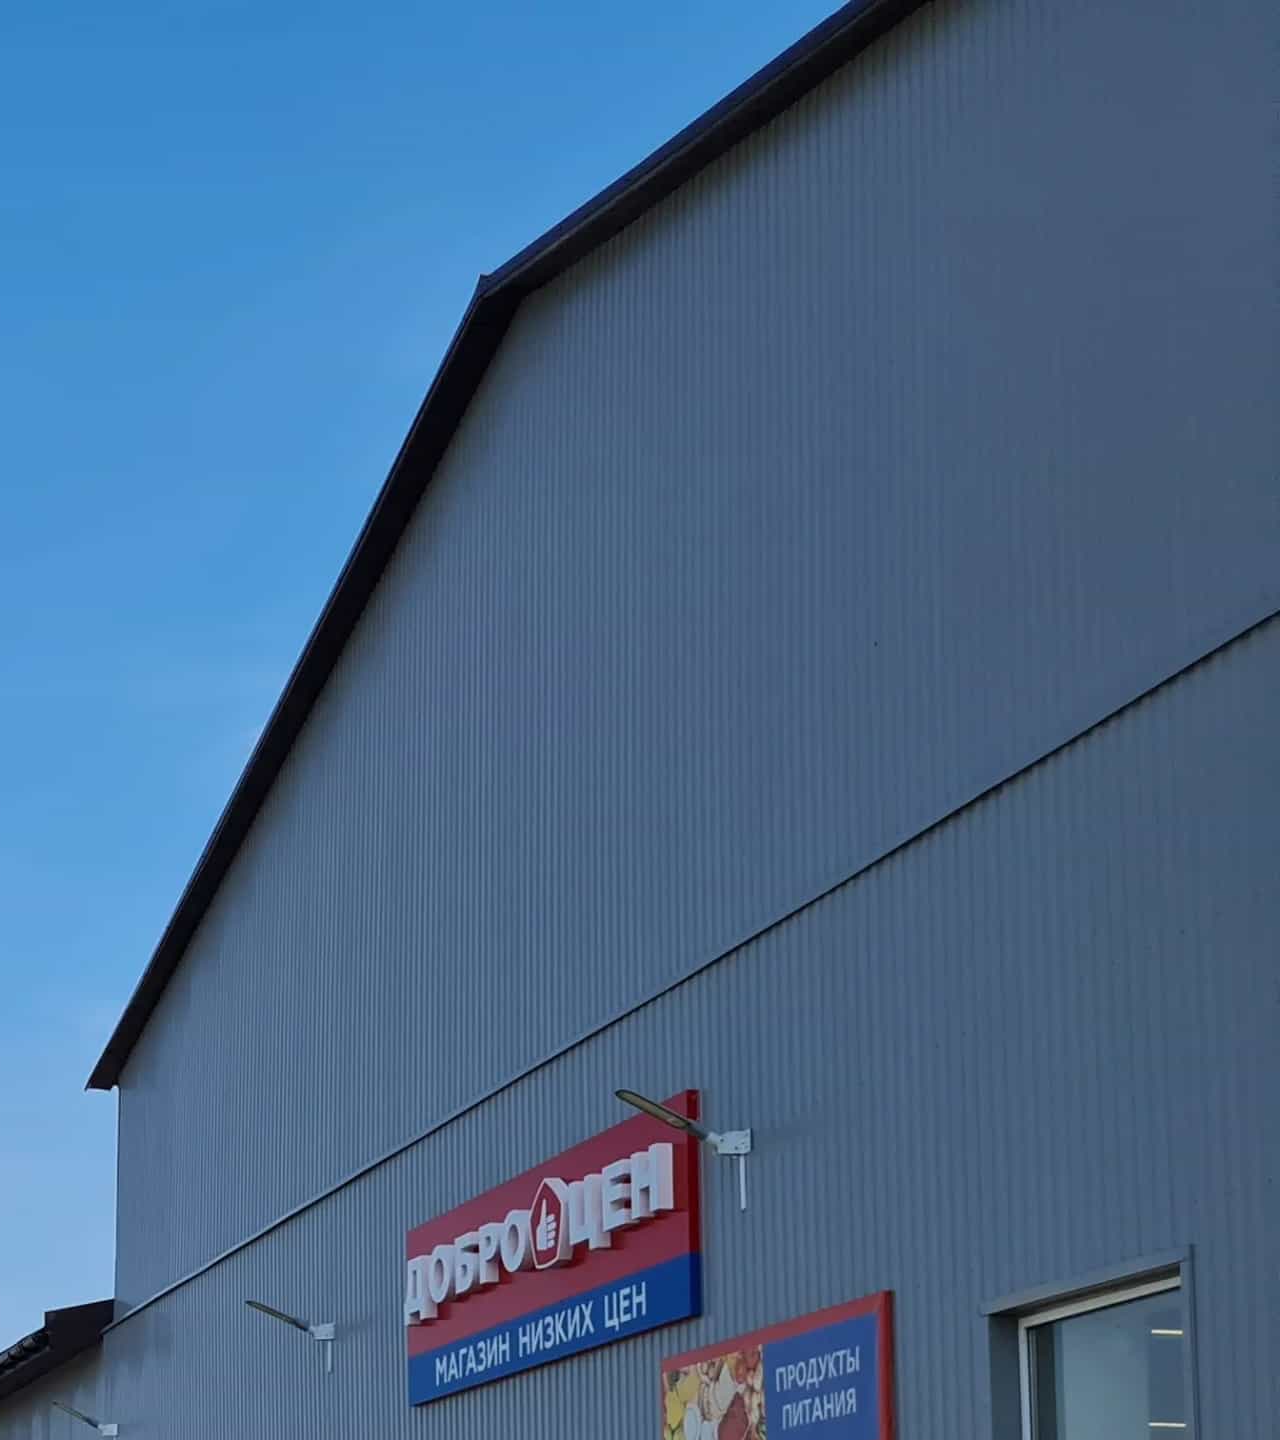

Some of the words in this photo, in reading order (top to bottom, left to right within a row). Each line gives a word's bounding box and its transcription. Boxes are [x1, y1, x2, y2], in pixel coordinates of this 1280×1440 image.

[435, 1331, 511, 1387] МАГАЗИН
[518, 1300, 596, 1357] НИЗКИХ
[604, 1281, 647, 1331] ЦЕН
[775, 1345, 860, 1393] ПРОДУКТЫ
[782, 1387, 857, 1430] ПИТАНИЯ
